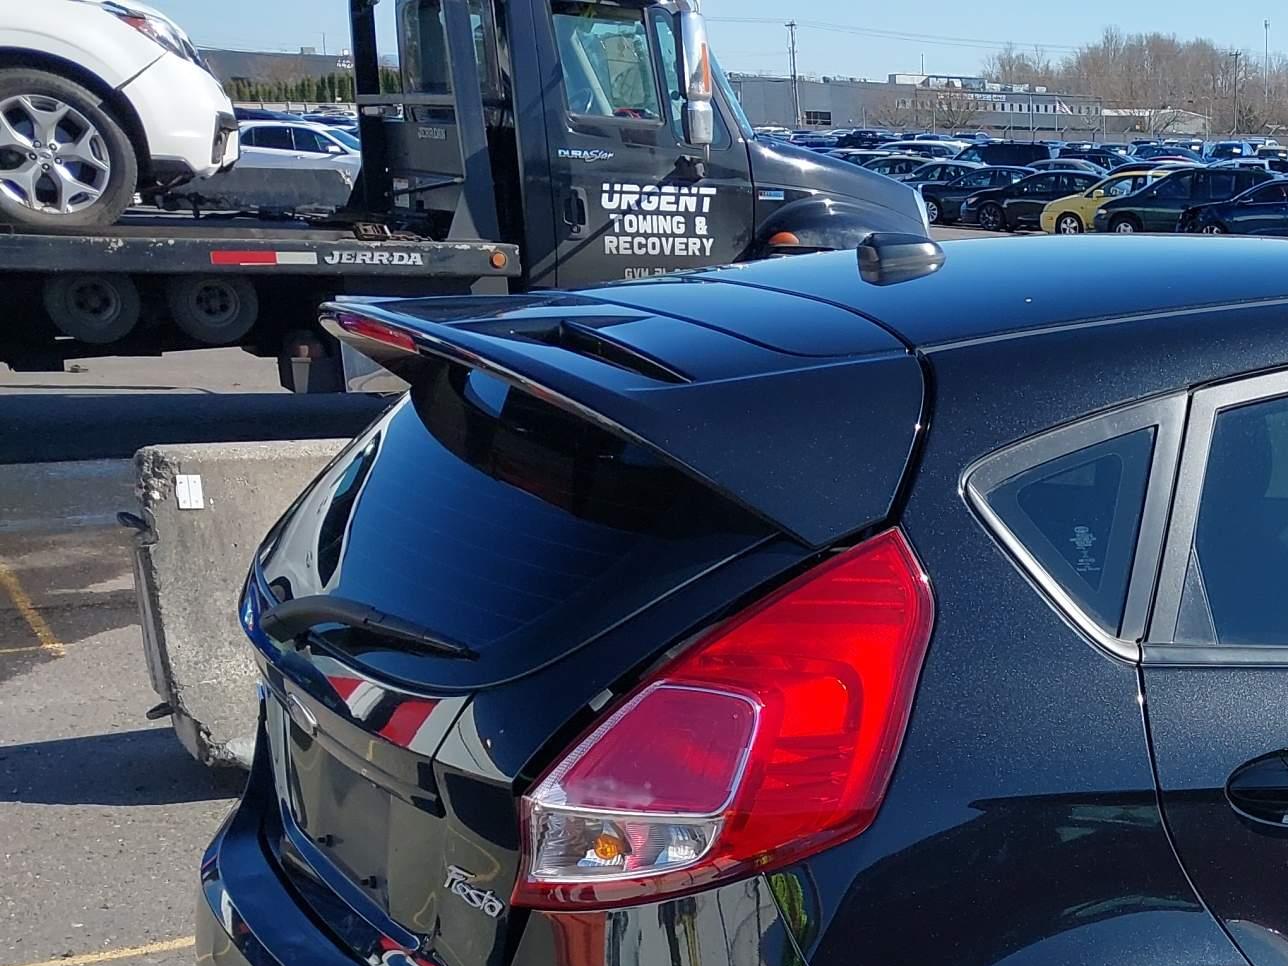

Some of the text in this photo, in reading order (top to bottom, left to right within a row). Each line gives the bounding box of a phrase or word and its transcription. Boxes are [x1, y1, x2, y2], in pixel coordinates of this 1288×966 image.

[601, 183, 717, 213] URGENT
[609, 214, 708, 236] TOWING &
[604, 236, 714, 257] RECOVERY
[444, 865, 506, 917] Fiesta
